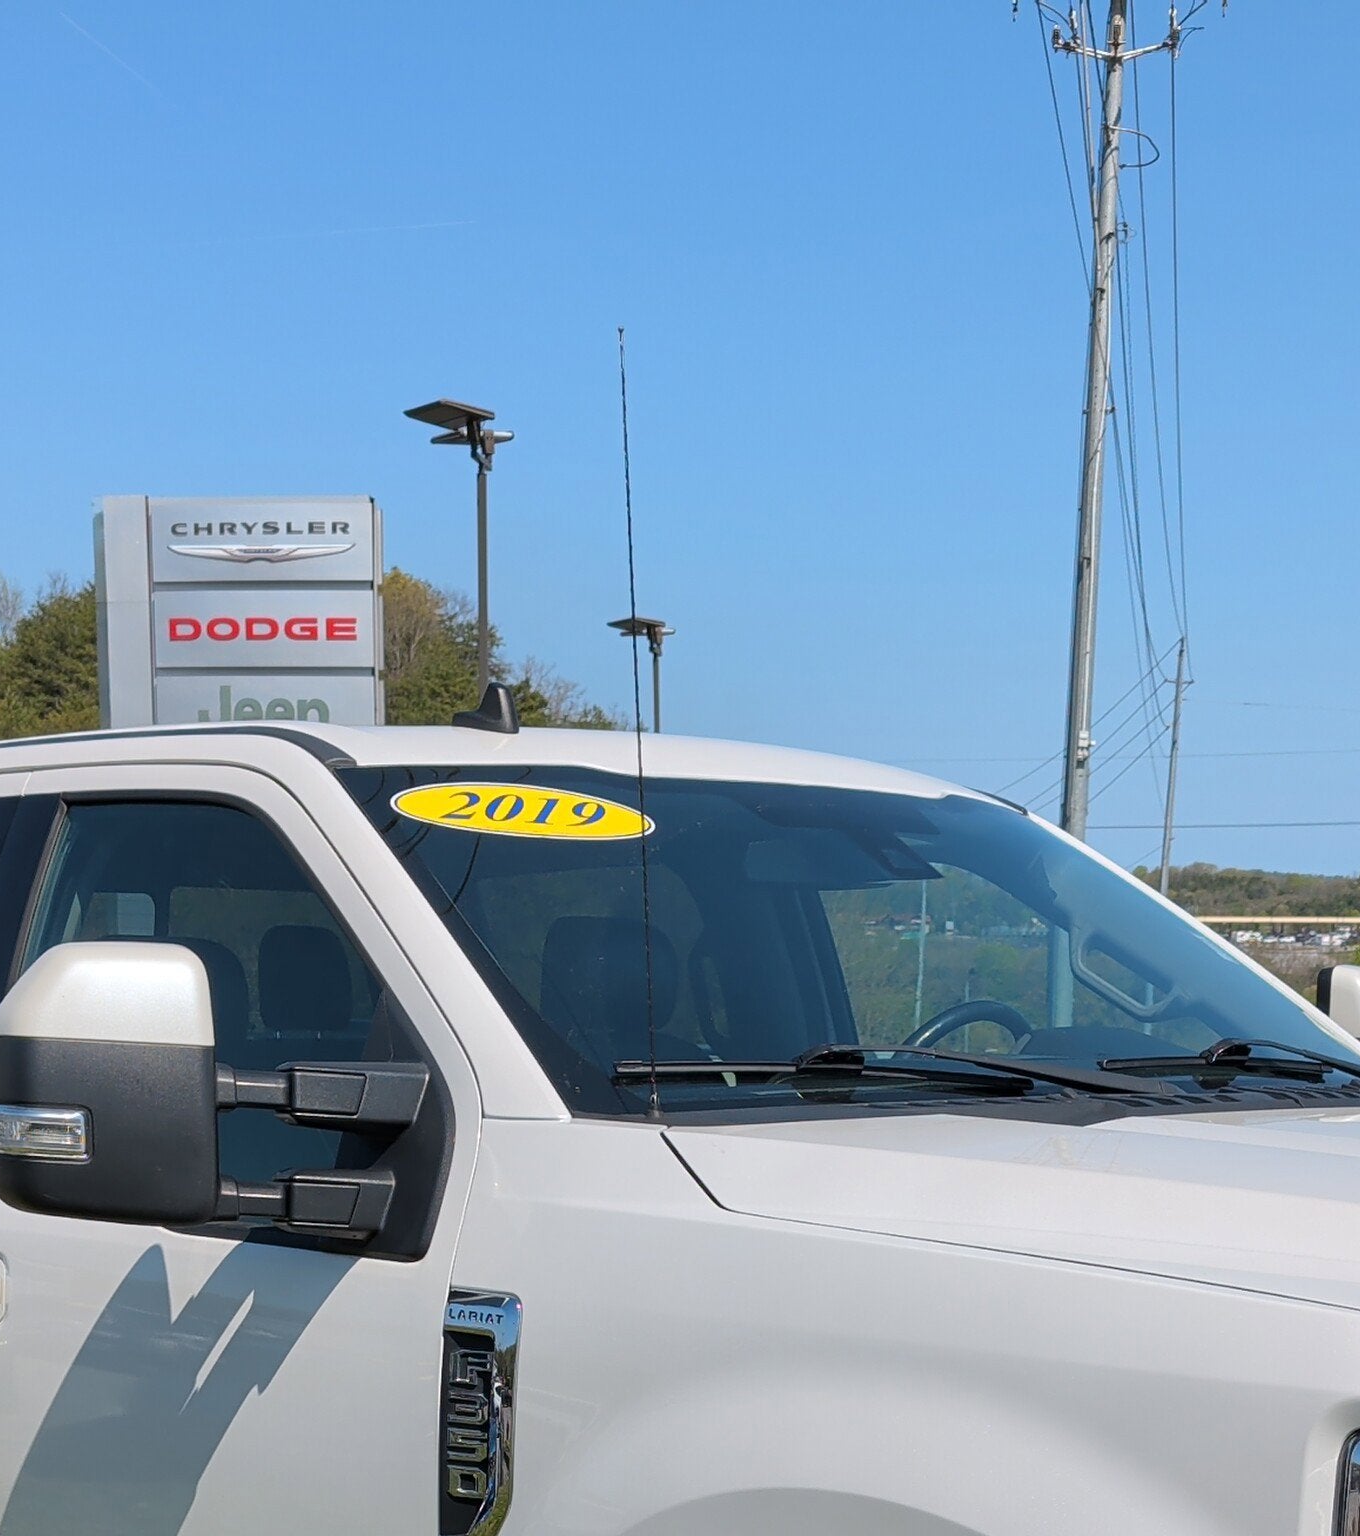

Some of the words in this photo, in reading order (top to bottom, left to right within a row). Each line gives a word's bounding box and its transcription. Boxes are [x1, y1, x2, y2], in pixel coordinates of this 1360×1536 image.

[170, 521, 350, 537] CHRYSLER
[168, 617, 357, 642] DODGE
[439, 791, 606, 827] 2019
[448, 1308, 505, 1325] LARIAT
